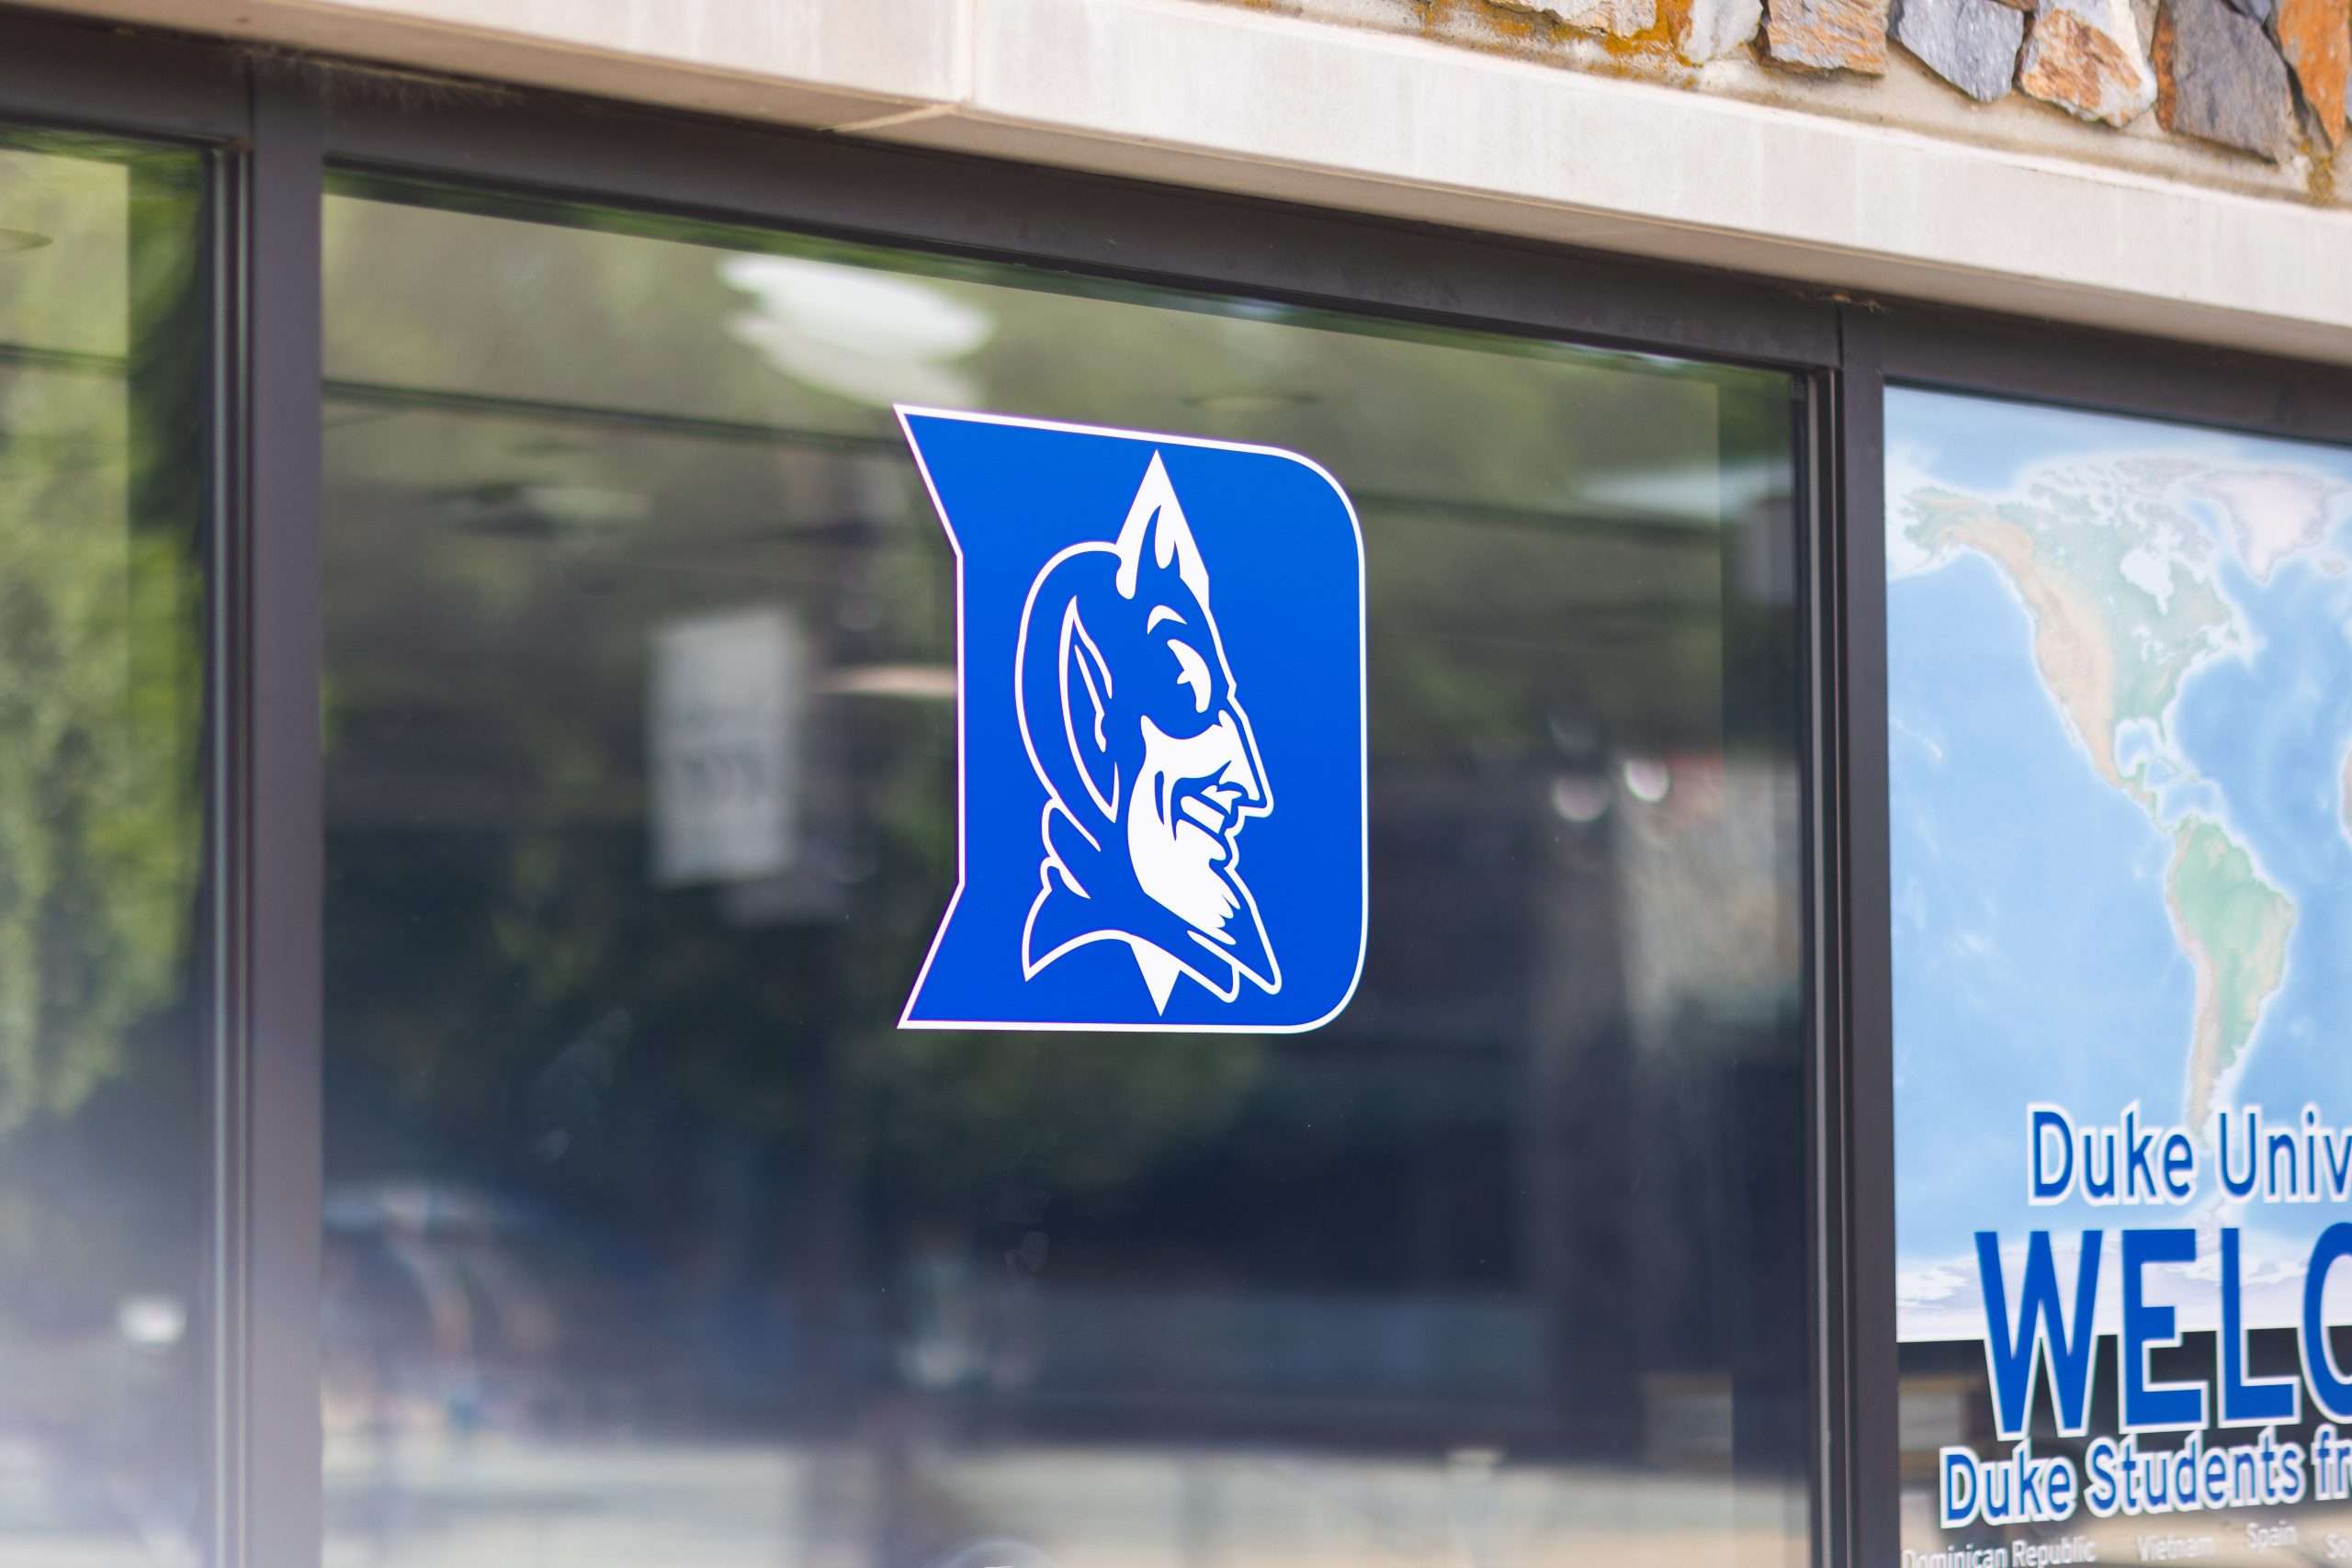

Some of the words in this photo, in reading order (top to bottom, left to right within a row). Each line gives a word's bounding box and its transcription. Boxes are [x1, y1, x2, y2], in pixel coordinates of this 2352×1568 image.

[2029, 1103, 2197, 1205] Duke
[2216, 1103, 2352, 1203] Univ
[1939, 1440, 2076, 1528] Duke
[2085, 1426, 2307, 1516] Students
[2311, 1424, 2352, 1500] fr
[2137, 1534, 2215, 1561] Vietnam
[2246, 1520, 2297, 1550] Spain
[1901, 1544, 2008, 1568] Dominican
[2011, 1536, 2096, 1568] Republic
